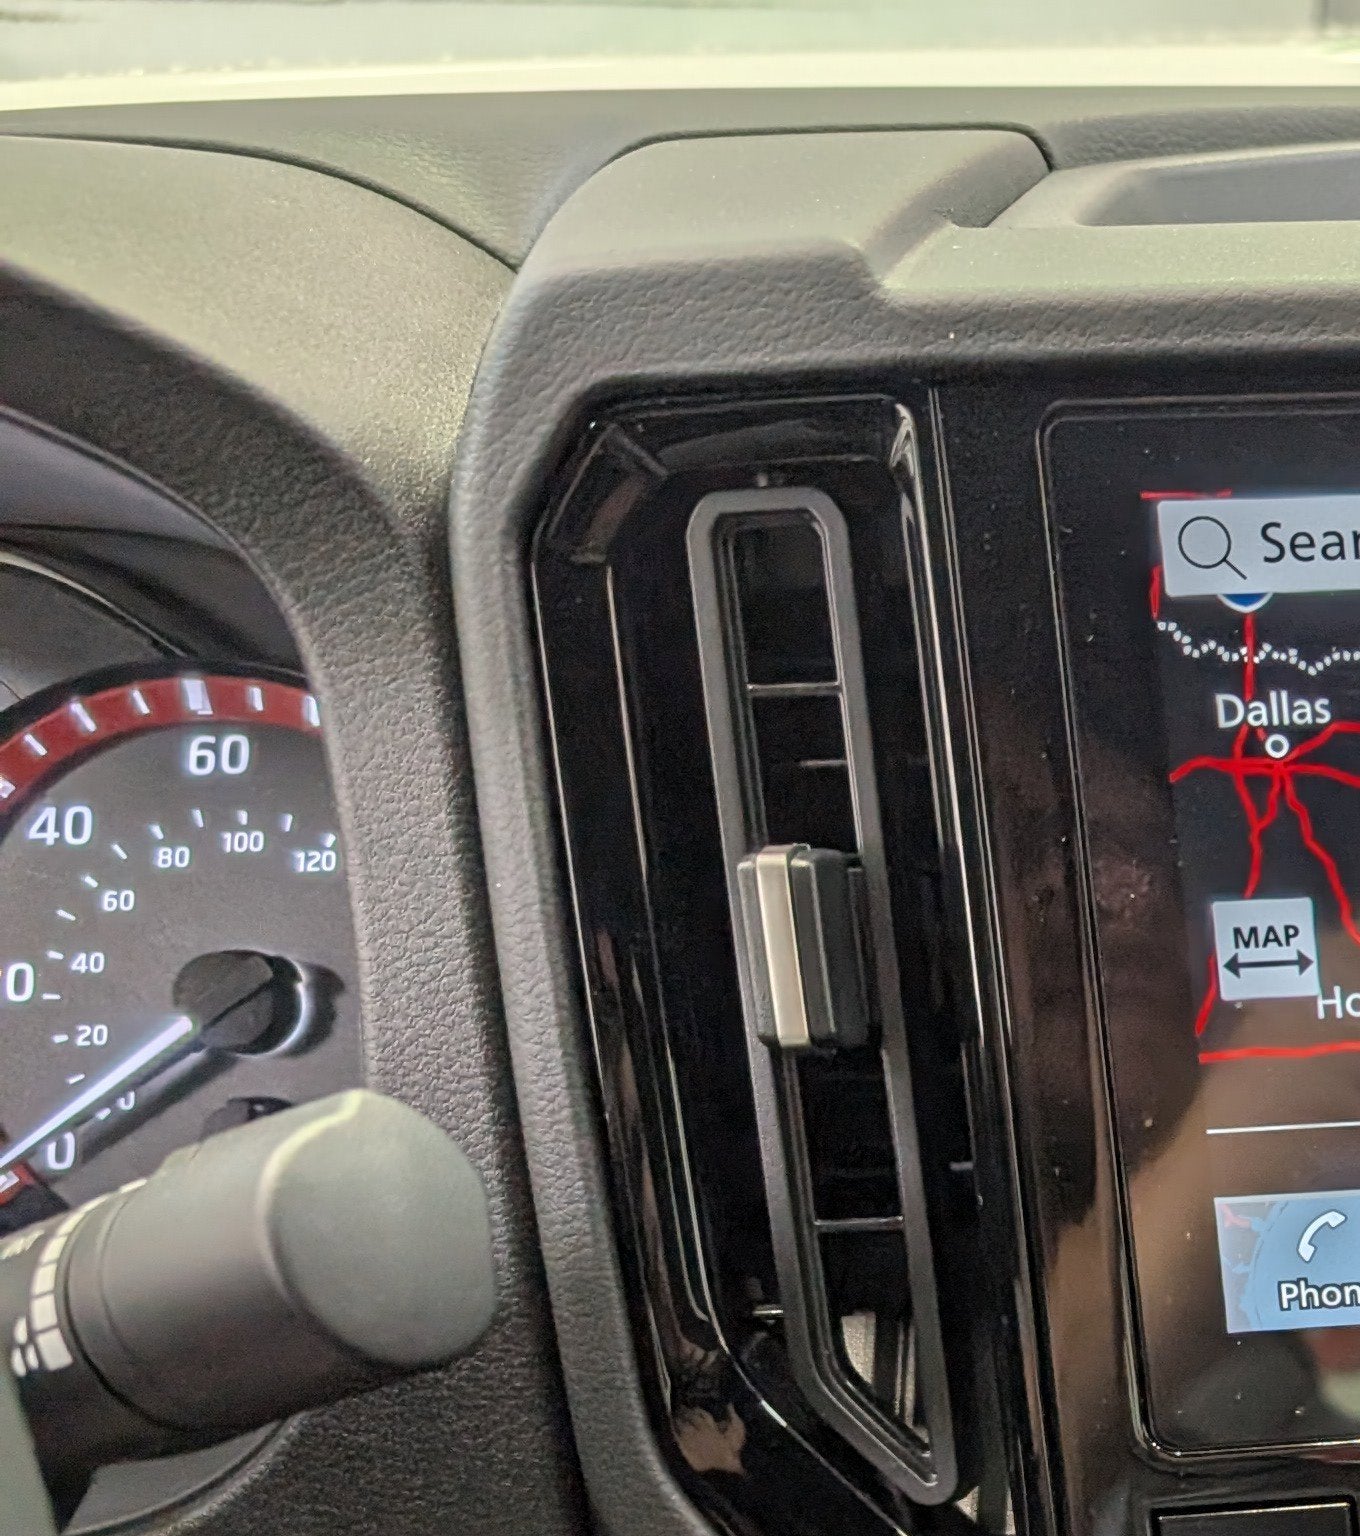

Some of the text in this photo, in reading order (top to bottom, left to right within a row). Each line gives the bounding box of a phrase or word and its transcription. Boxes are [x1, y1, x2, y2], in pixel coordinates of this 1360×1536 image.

[1216, 693, 1332, 728] Dallas
[187, 735, 249, 776] 60
[28, 805, 92, 846] 40
[223, 831, 264, 853] 100
[156, 847, 190, 869] 80
[297, 850, 337, 873] 120
[102, 890, 135, 911] 60
[1232, 925, 1300, 950] MAP
[71, 952, 104, 973] 40
[0, 962, 34, 1001] 0
[76, 1024, 108, 1046] 20
